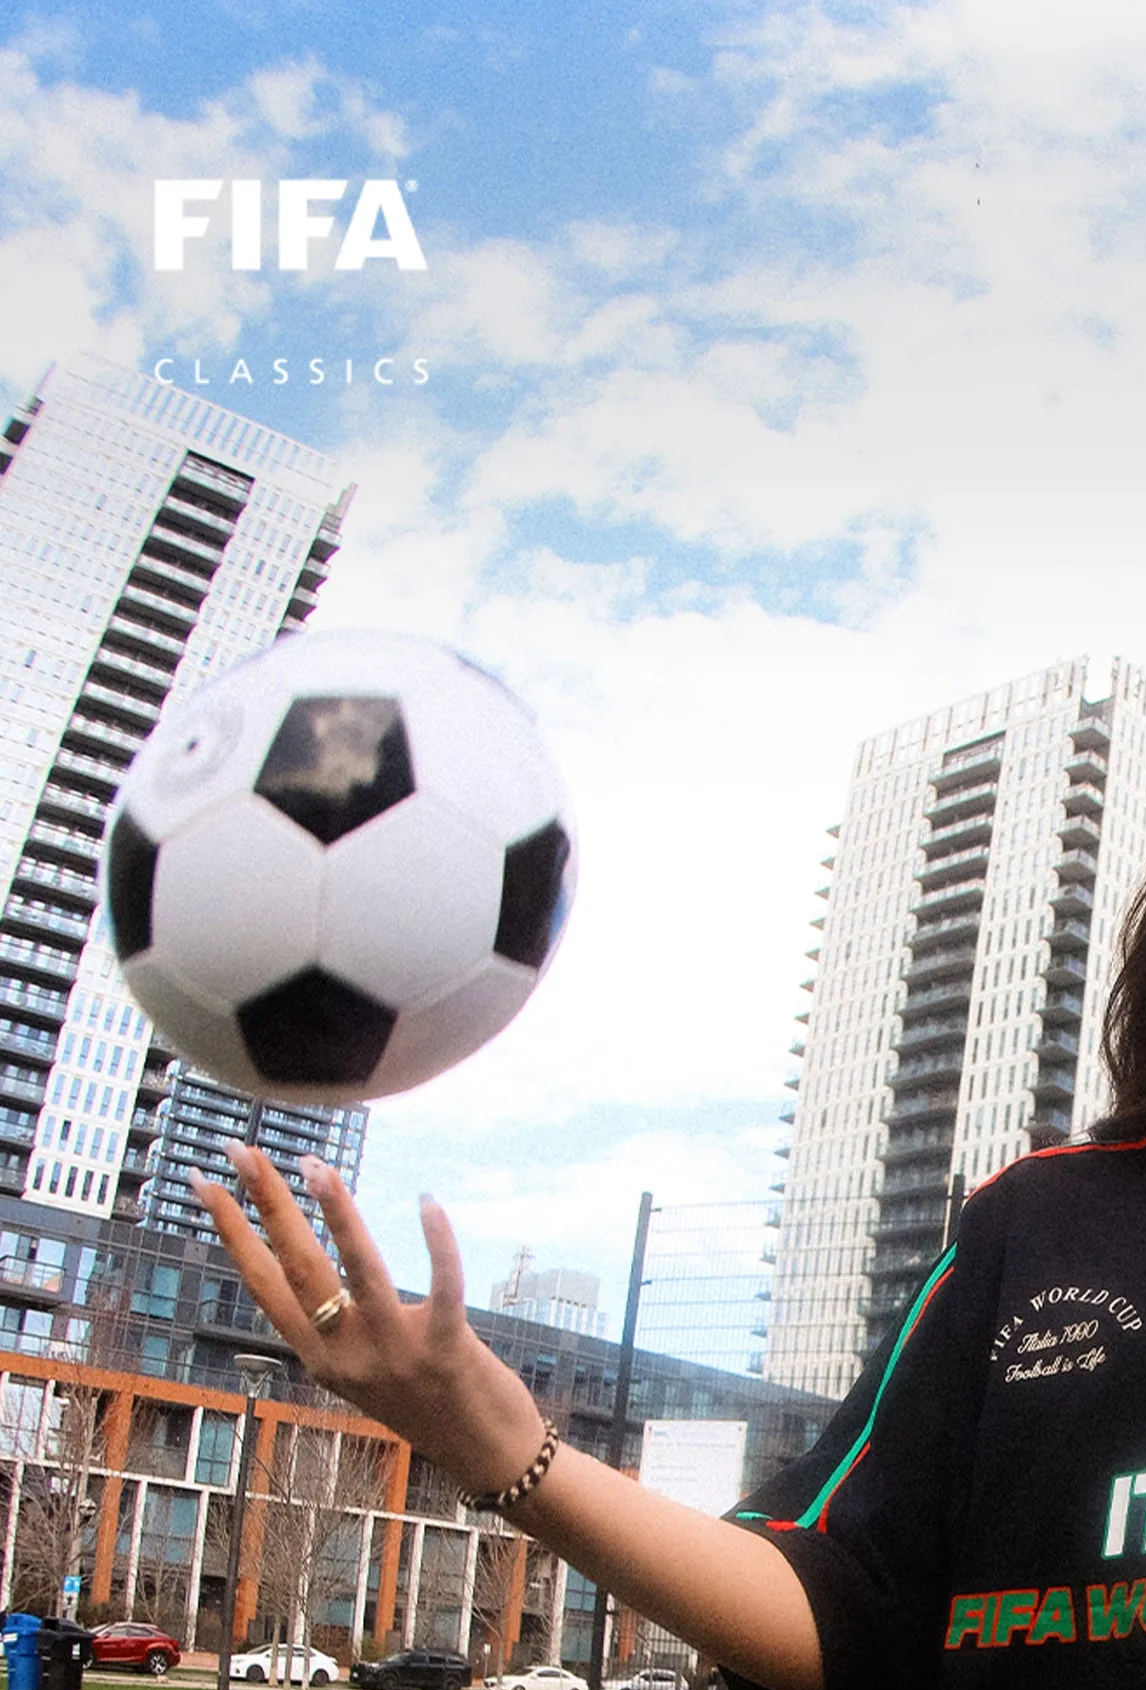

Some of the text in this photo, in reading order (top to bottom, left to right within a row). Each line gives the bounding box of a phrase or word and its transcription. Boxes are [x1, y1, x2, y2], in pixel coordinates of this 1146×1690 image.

[1030, 1287, 1109, 1312] WORLD
[1108, 1296, 1143, 1331] CUP
[1059, 1319, 1099, 1345] 1990
[1005, 1355, 1061, 1383] Football
[944, 1586, 1077, 1650] FIFA
